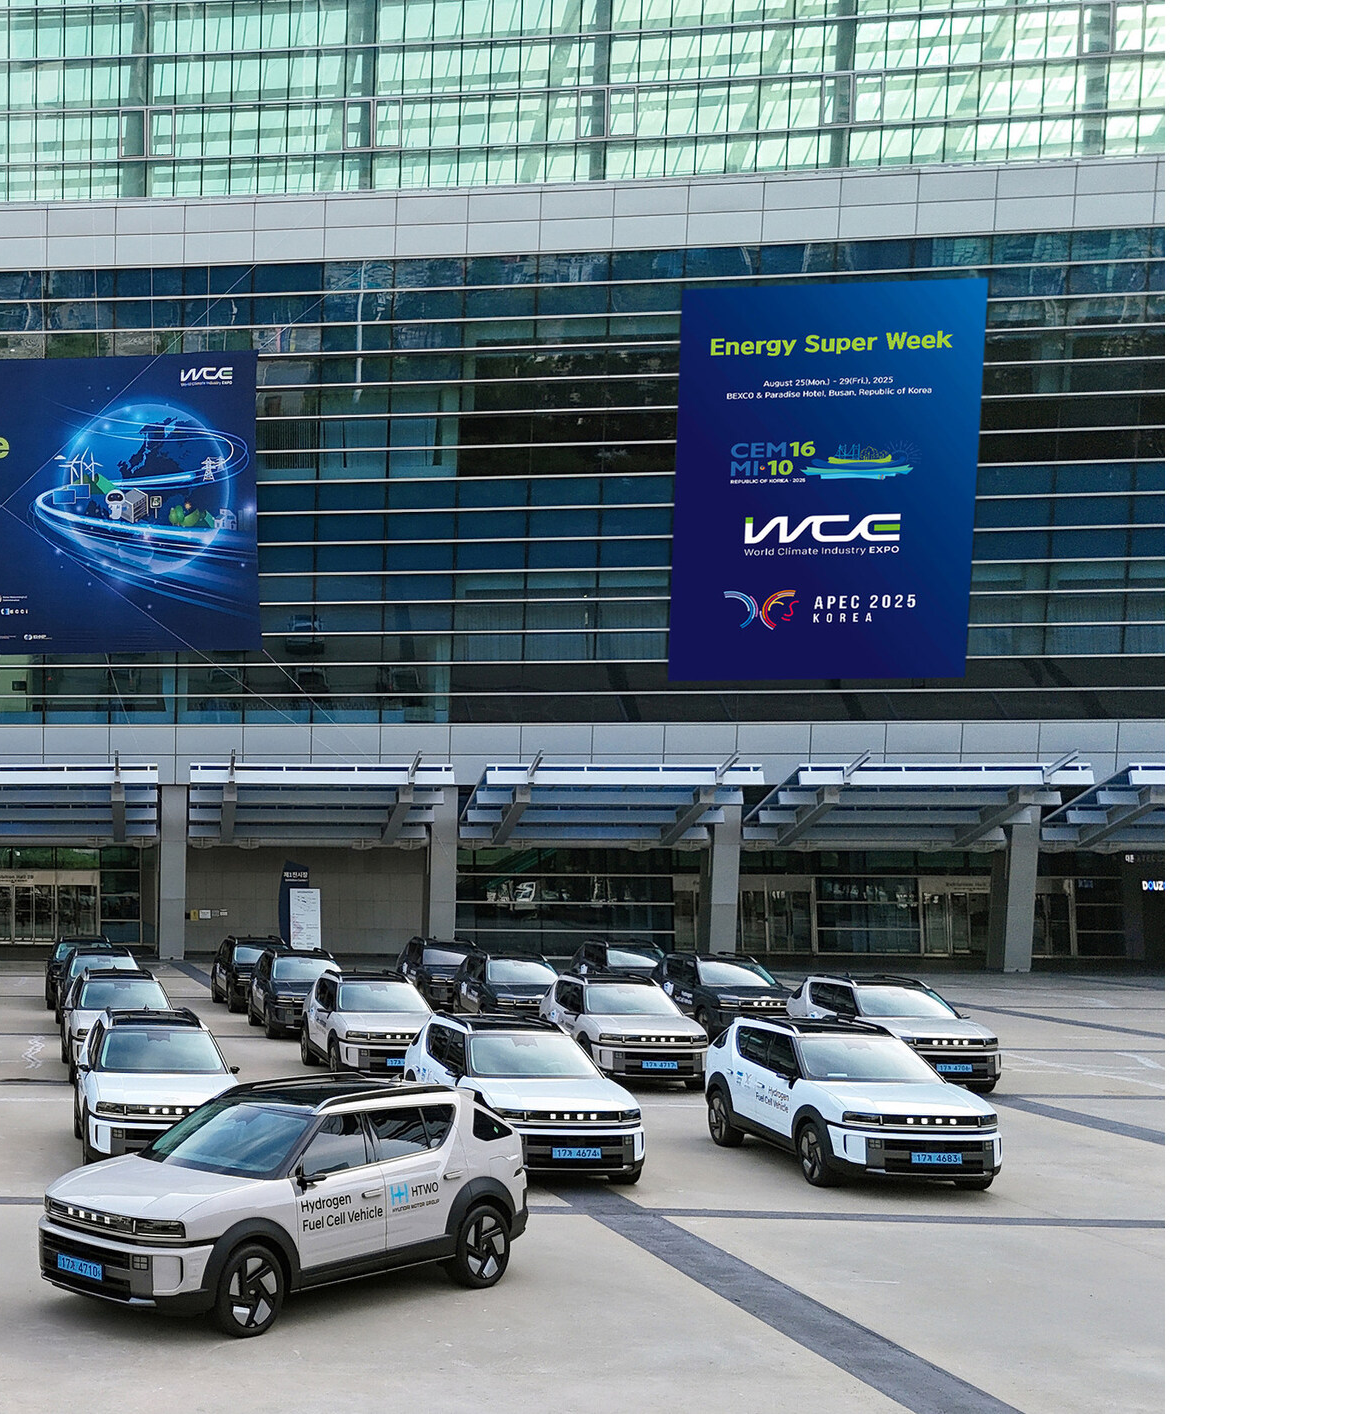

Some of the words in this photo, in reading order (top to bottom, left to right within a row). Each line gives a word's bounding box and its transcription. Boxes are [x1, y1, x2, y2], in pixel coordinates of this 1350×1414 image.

[710, 338, 797, 357] Energy
[805, 334, 878, 354] Super
[886, 330, 953, 350] Week
[763, 380, 793, 388] August
[795, 378, 830, 386] 25(Mon.)
[873, 376, 894, 384] 2025
[726, 392, 754, 400] BEXCO
[764, 390, 801, 399] Paradise
[802, 390, 826, 398] Hotel,
[859, 387, 894, 397] Republic
[897, 387, 906, 395] of
[908, 386, 932, 394] Korea
[744, 548, 775, 556] World
[777, 547, 819, 556] Climate
[821, 546, 866, 556] Industry
[869, 546, 900, 554] EXPO
[814, 595, 860, 609] APEC
[869, 594, 917, 608] 2025
[813, 612, 873, 623] KOREA
[576, 1149, 597, 1157] 4674
[936, 1154, 958, 1162] 4683
[411, 1182, 439, 1197] HTWO
[300, 1194, 352, 1214] Hydrogen
[302, 1216, 324, 1232] Fuel
[326, 1212, 346, 1227] Cell
[349, 1206, 383, 1223] Vehicle
[78, 1262, 98, 1277] 4710
